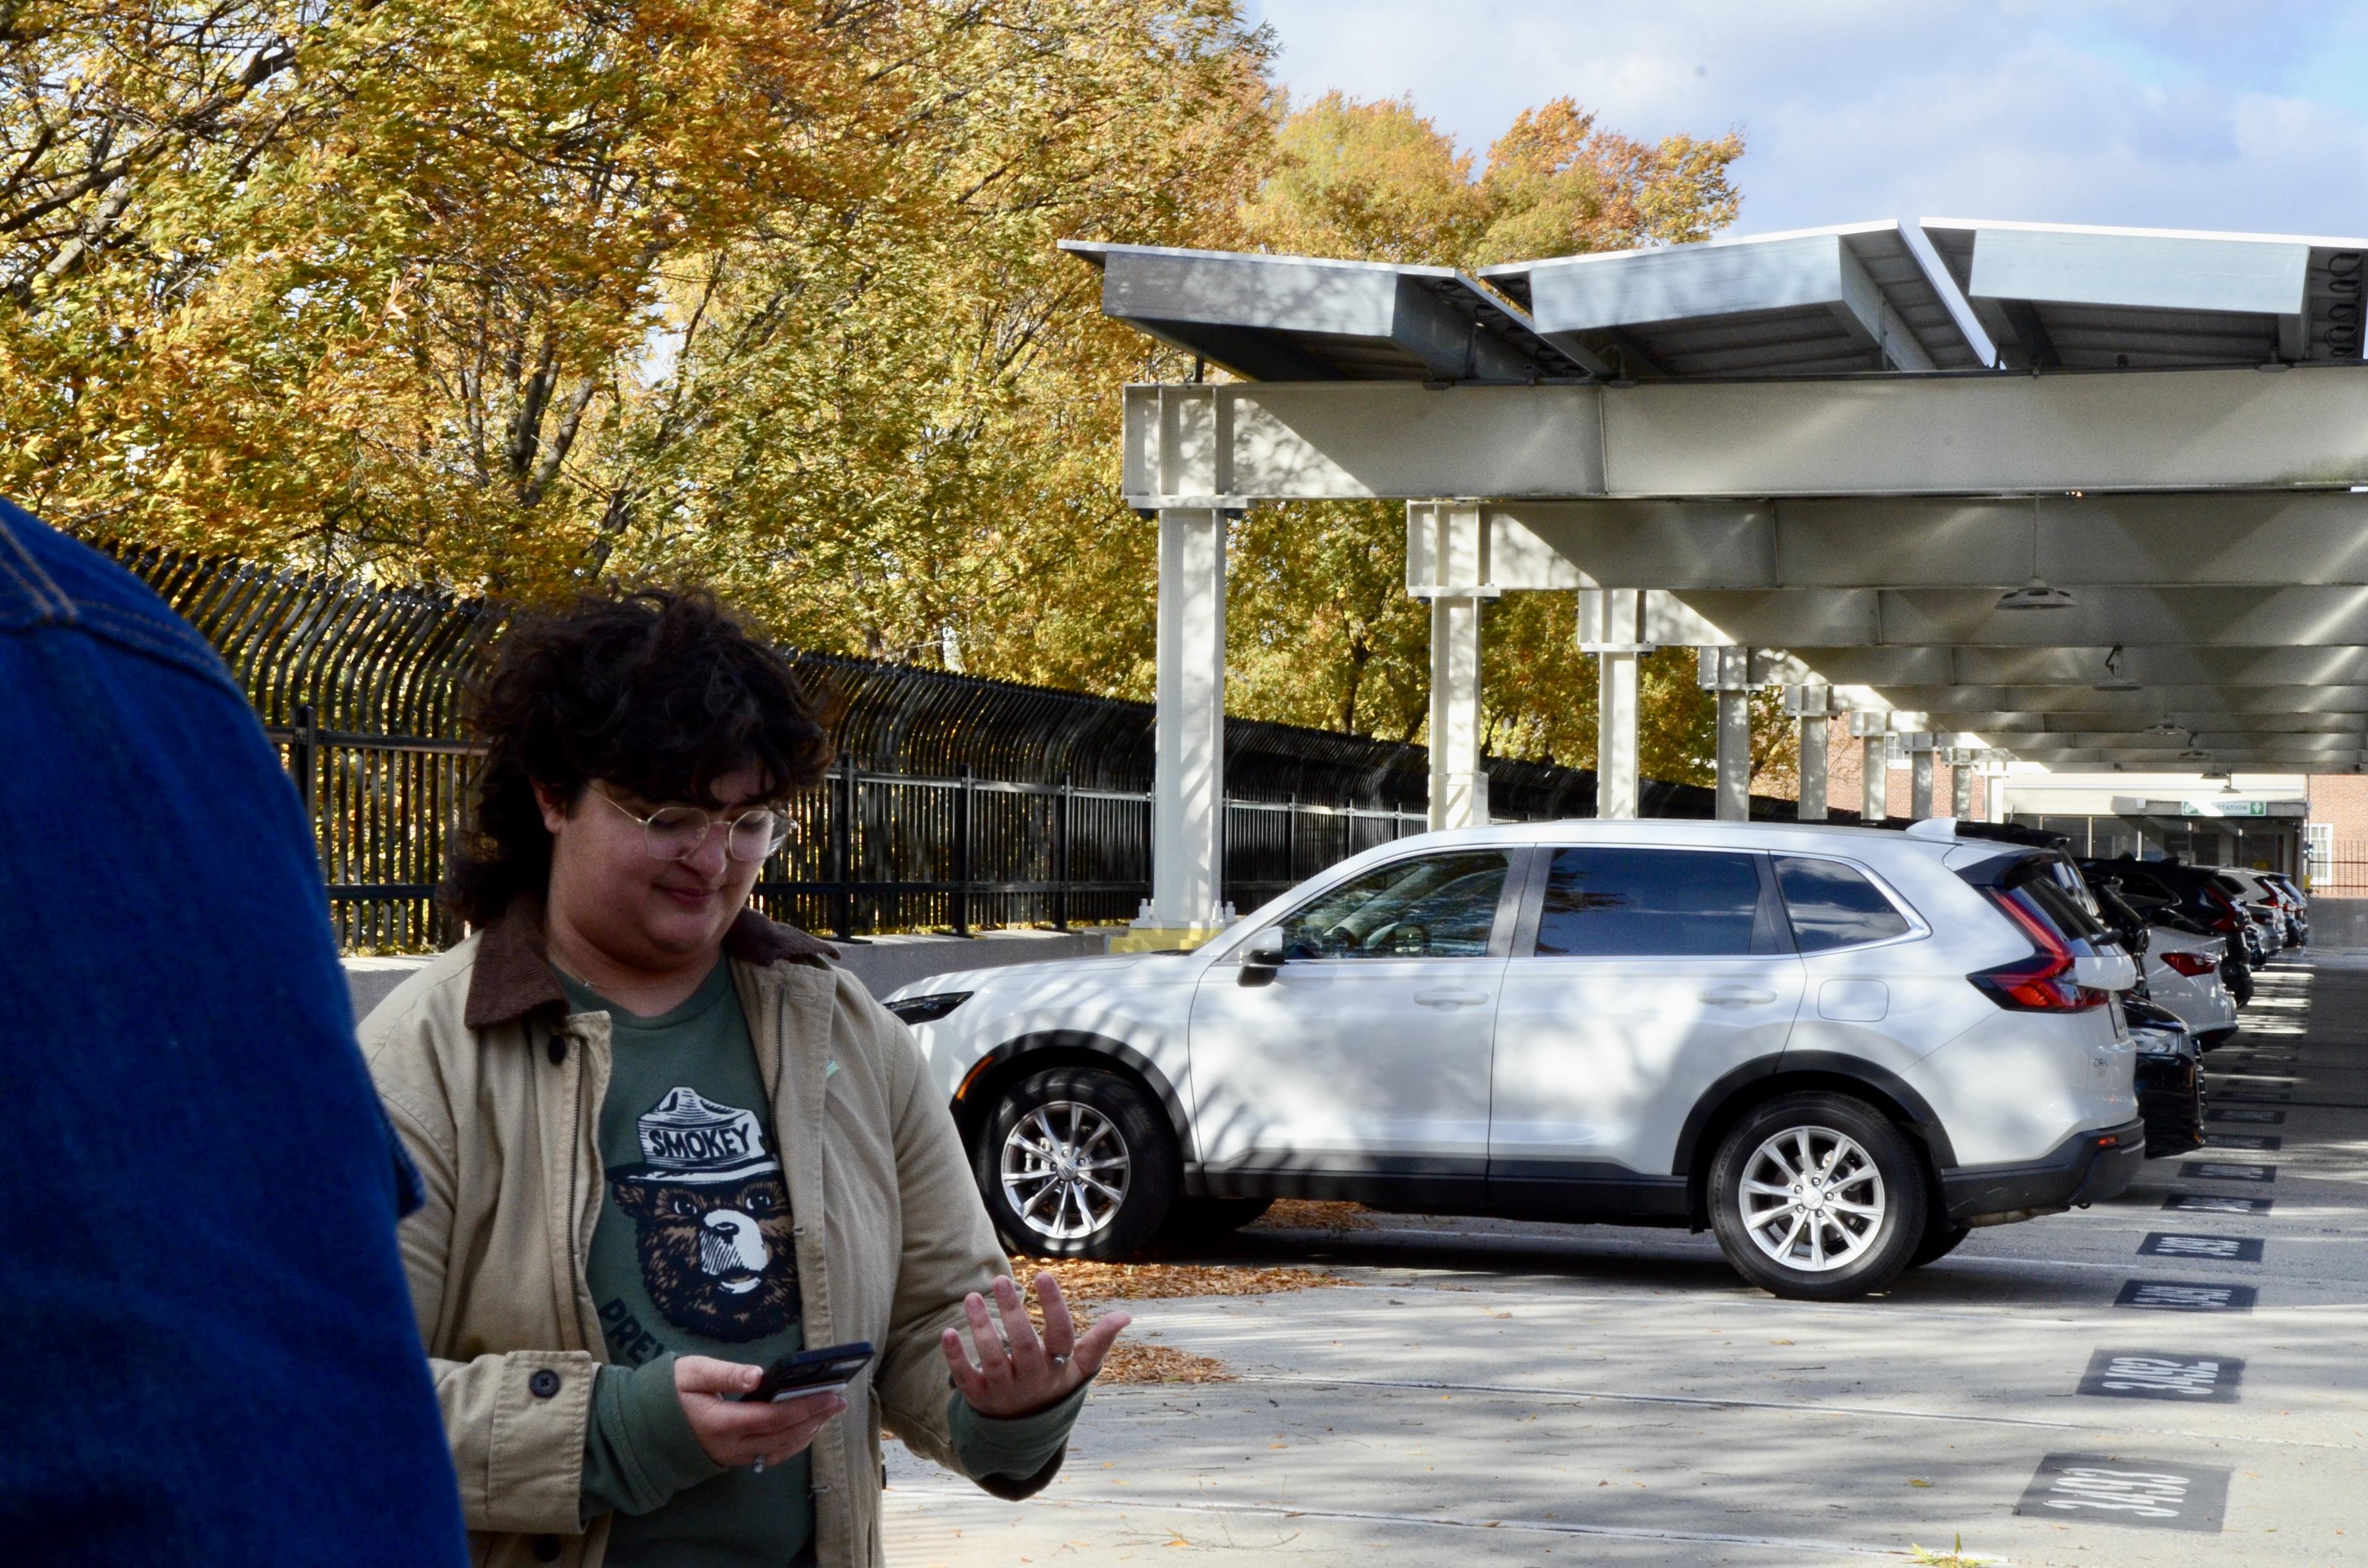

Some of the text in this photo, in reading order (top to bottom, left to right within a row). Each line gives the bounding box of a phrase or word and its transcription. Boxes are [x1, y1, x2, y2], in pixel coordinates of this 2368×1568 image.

[648, 1122, 750, 1159] SMOKEY
[2134, 1285, 2232, 1307] 3491
[2102, 1357, 2219, 1394] 3492
[2043, 1467, 2191, 1517] 3493
